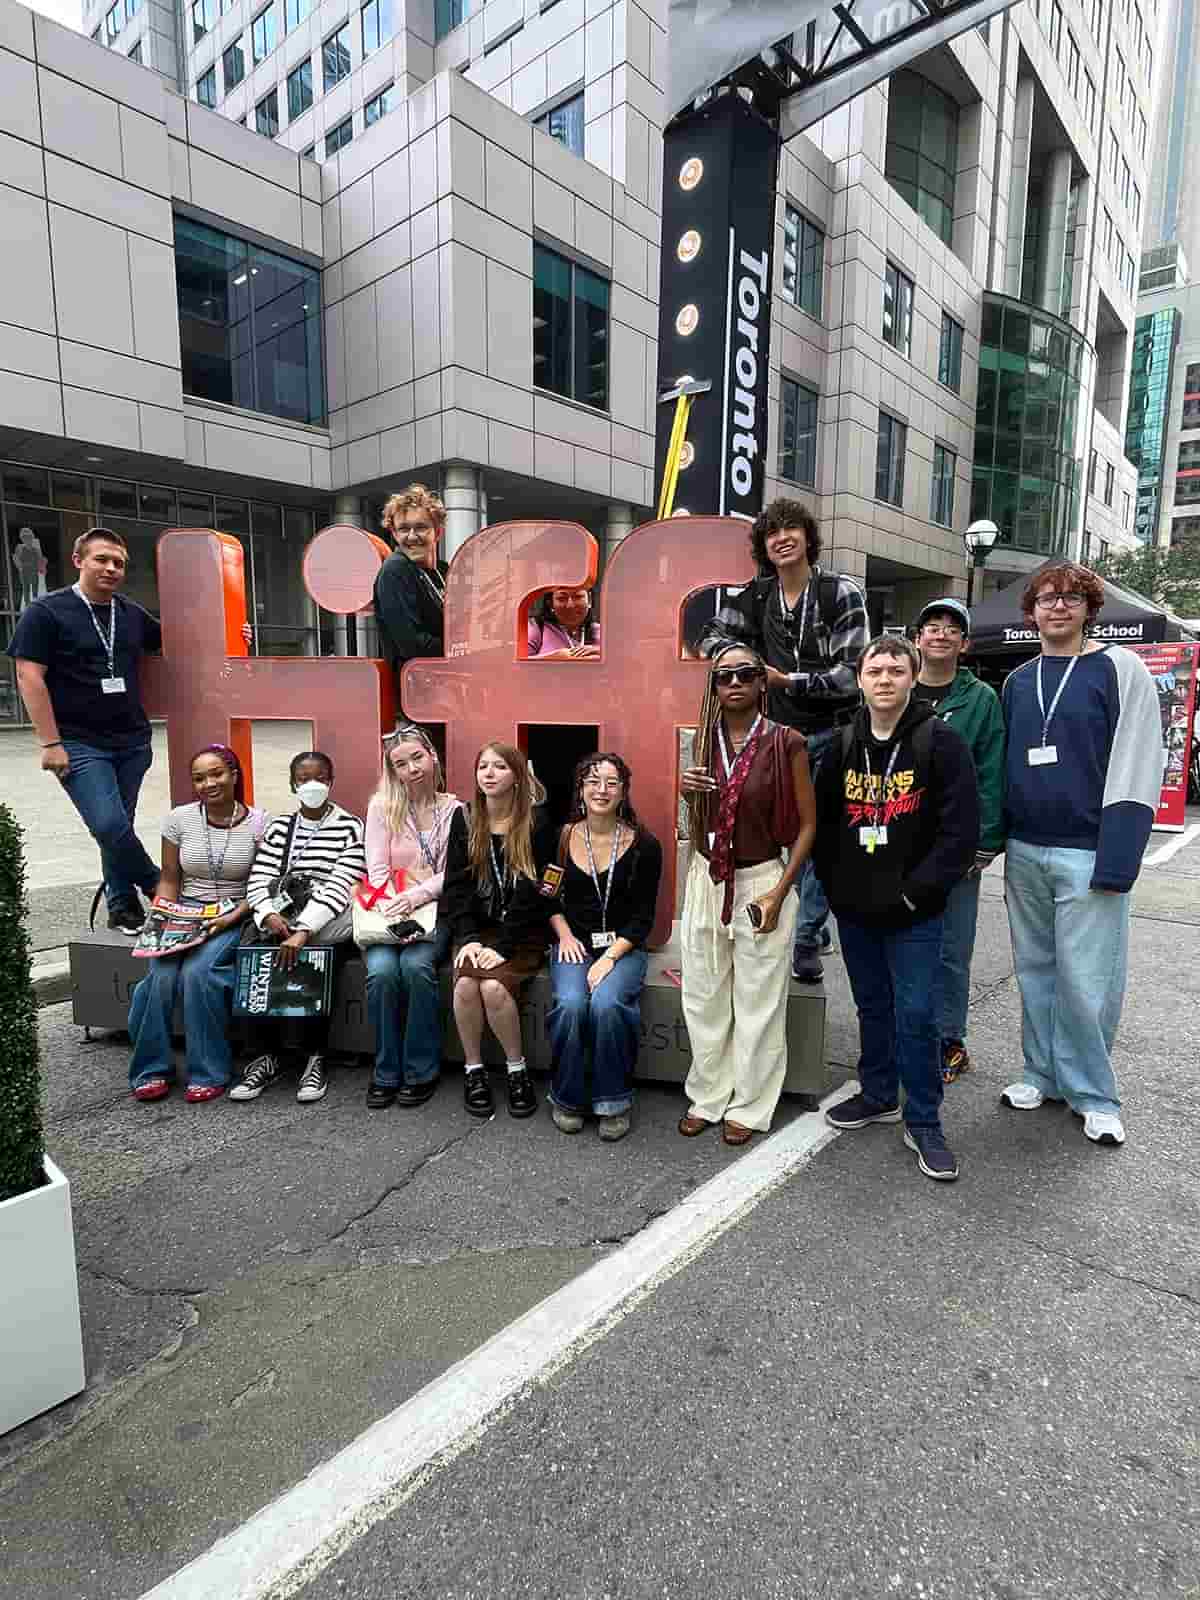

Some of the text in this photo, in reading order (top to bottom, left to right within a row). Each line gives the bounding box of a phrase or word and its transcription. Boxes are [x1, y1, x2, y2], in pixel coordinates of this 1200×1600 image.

[731, 249, 769, 496] Toronto
[1093, 623, 1144, 637] School
[139, 513, 756, 948] tiff
[256, 951, 272, 1013] WINTER
